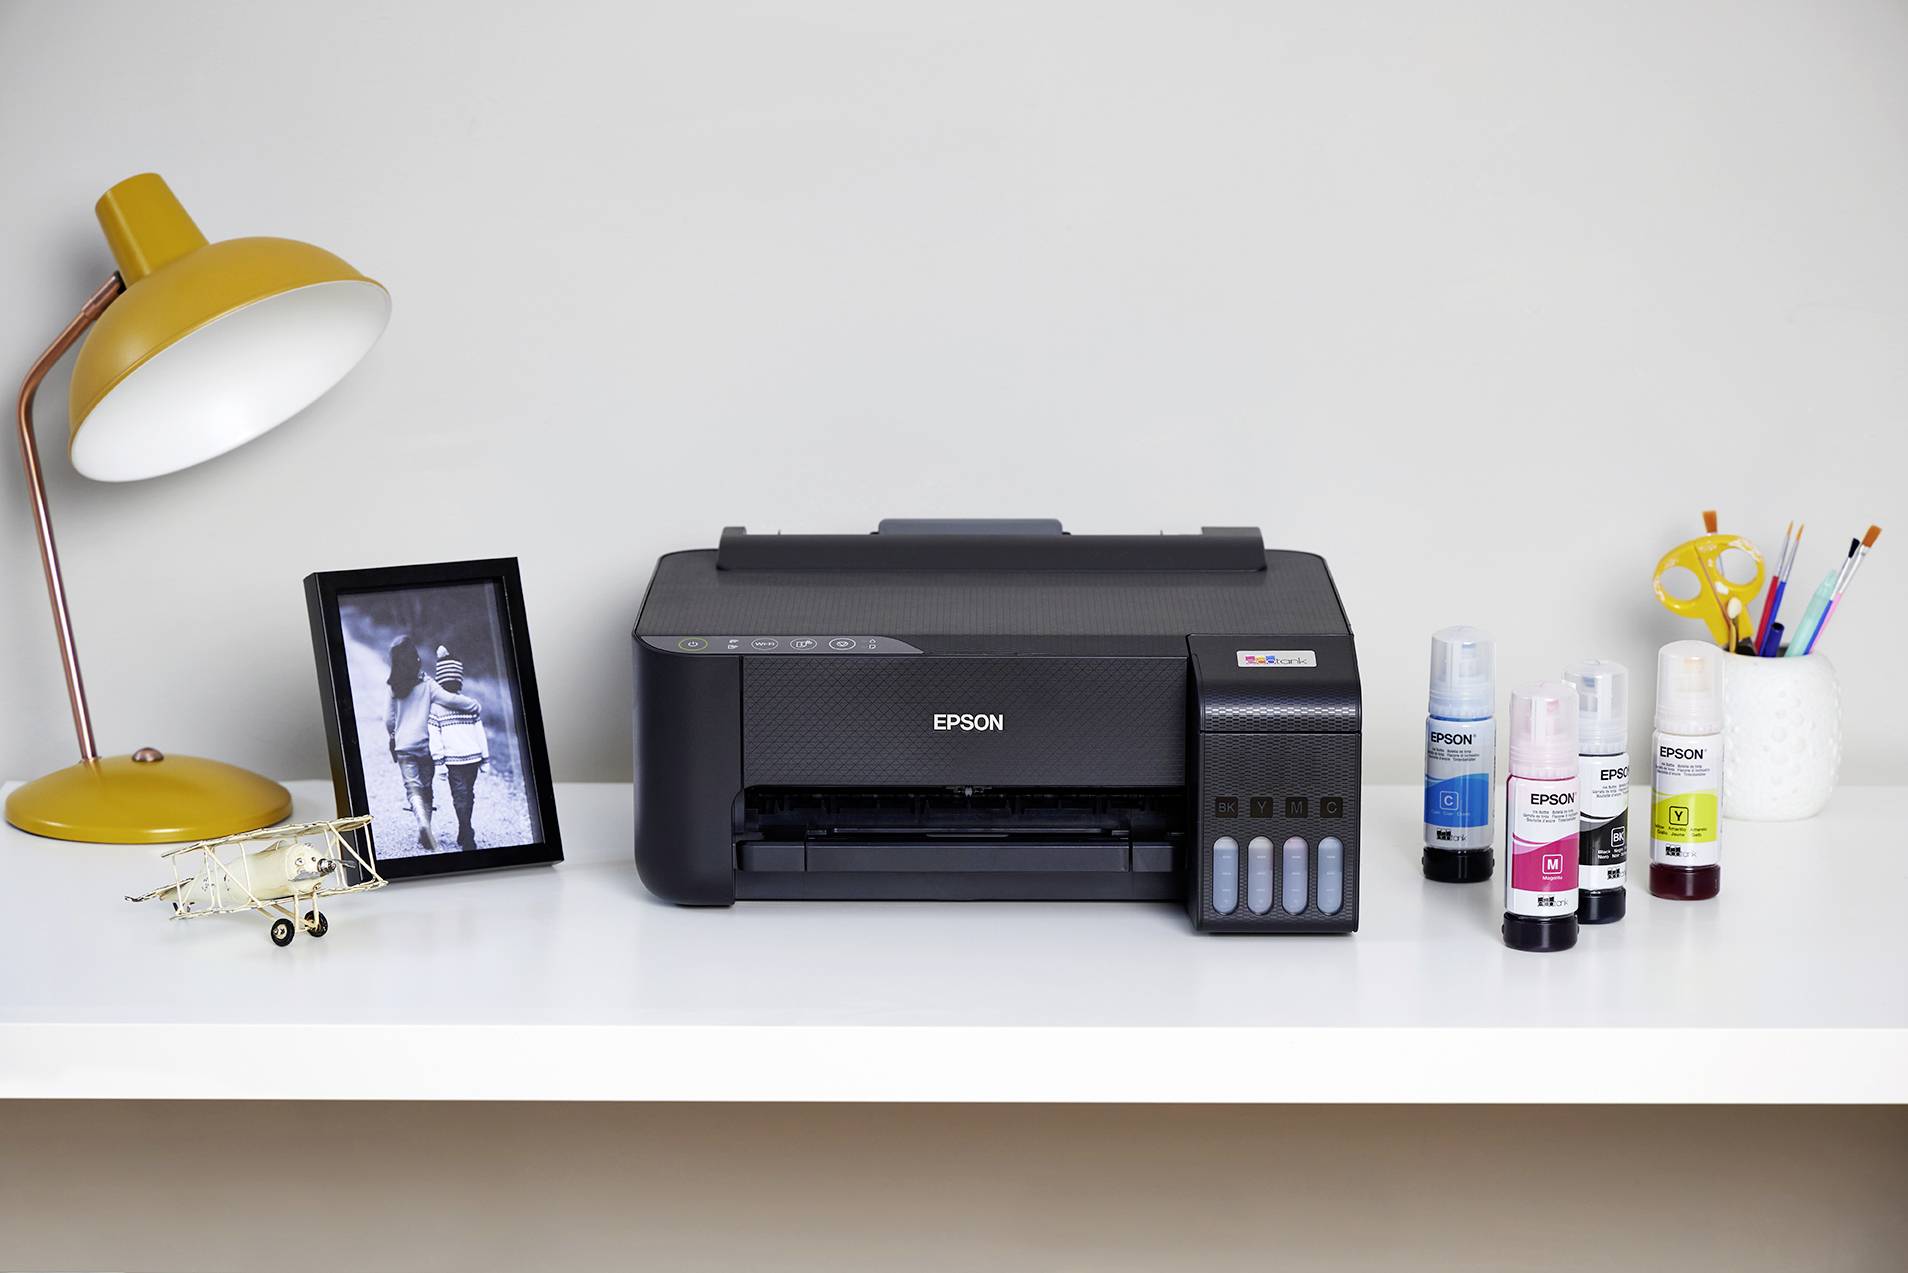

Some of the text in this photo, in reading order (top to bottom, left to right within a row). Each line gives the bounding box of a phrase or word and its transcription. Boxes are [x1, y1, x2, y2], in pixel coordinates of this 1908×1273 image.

[933, 713, 1004, 731] EPSON
[1431, 731, 1473, 745] EPSON
[1660, 745, 1704, 760] EPSON
[1600, 766, 1629, 781] EPSO
[1444, 795, 1454, 806] C
[1530, 792, 1575, 805] EPSON
[1219, 801, 1338, 814] BK Y M C
[1674, 810, 1684, 822] Y
[1613, 831, 1625, 843] BK
[1547, 858, 1559, 870] M
